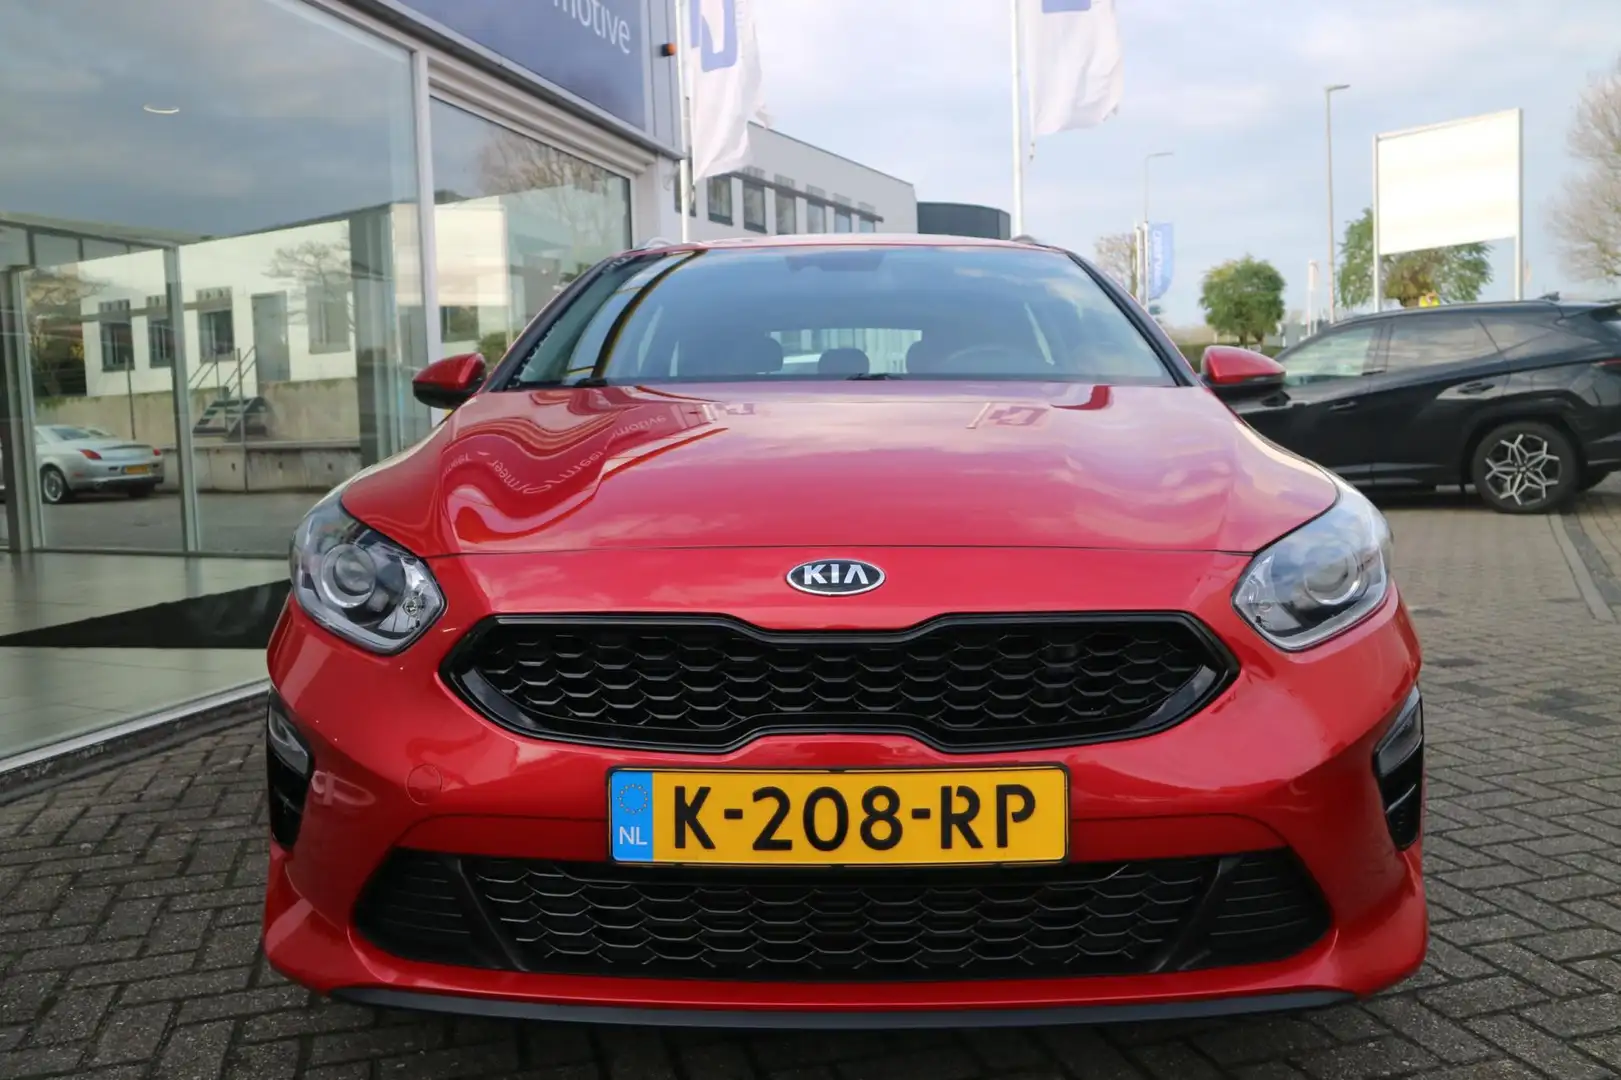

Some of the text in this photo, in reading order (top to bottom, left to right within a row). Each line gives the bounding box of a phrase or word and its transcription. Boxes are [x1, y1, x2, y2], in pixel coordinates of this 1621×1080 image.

[803, 563, 869, 585] KIA
[673, 783, 1036, 852] K-208-RP
[619, 827, 648, 846] NL
